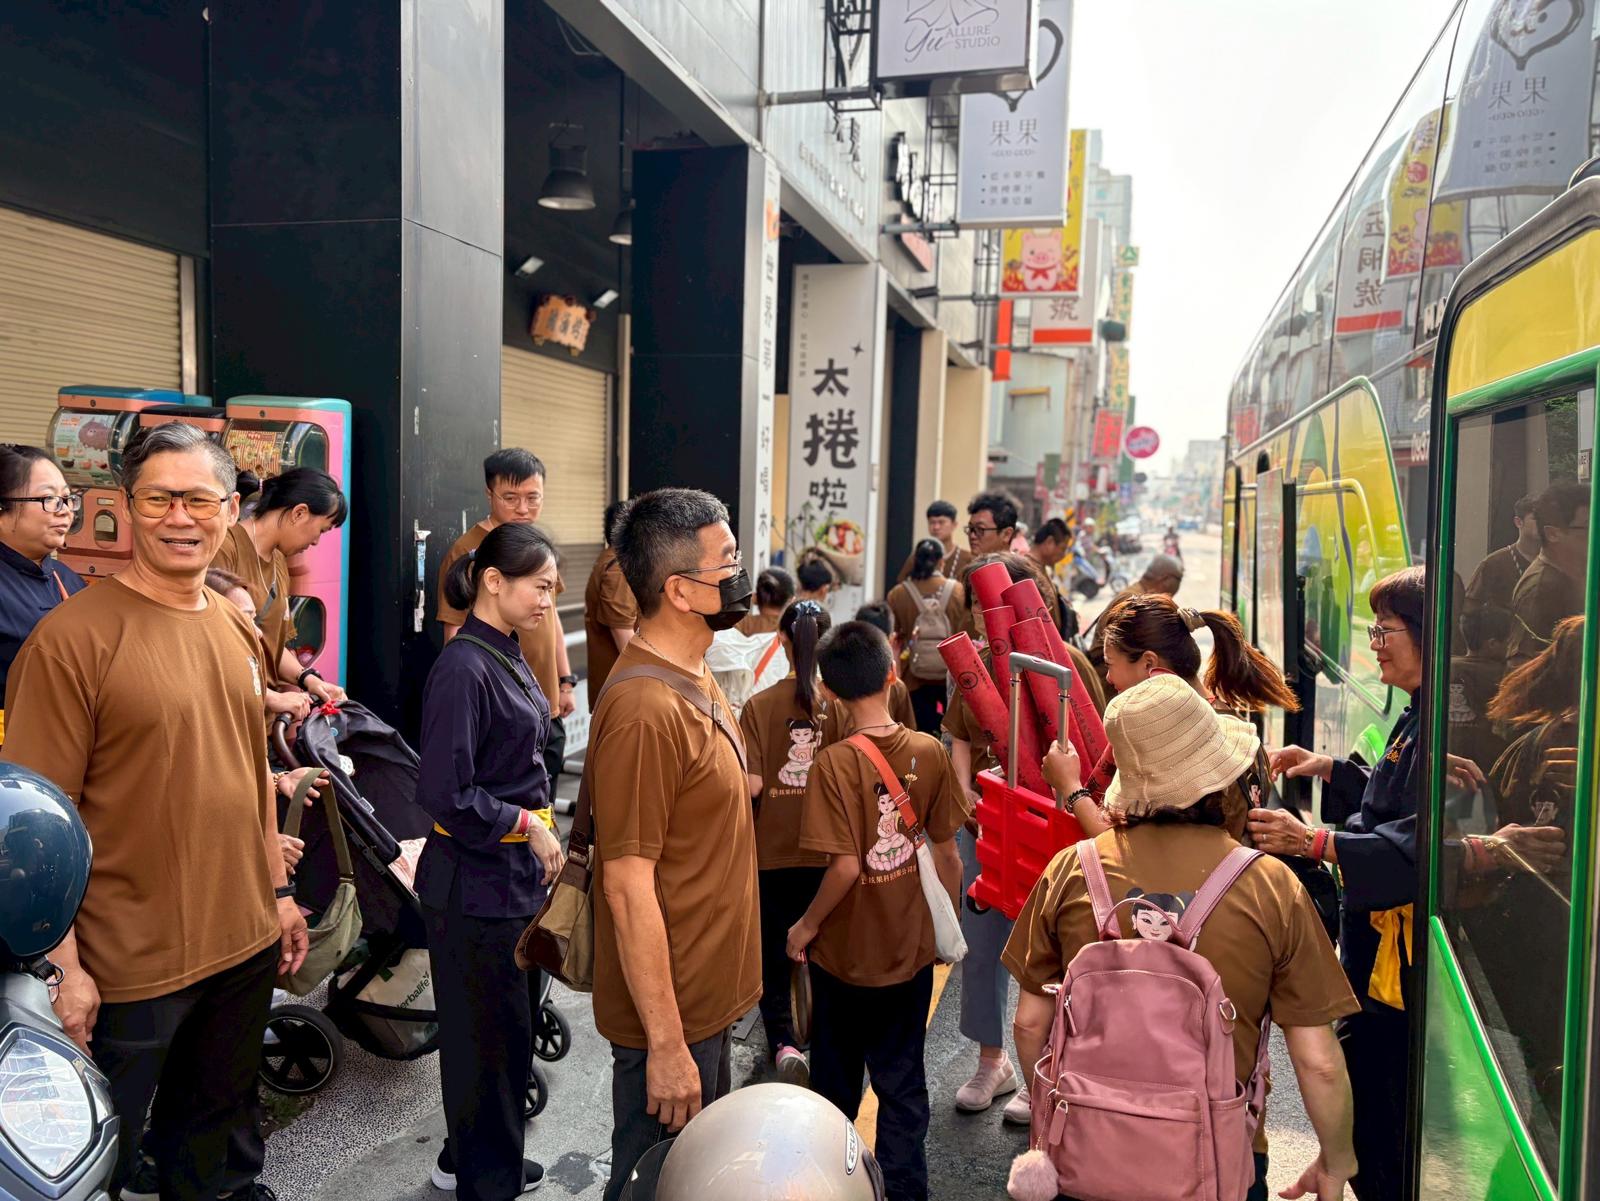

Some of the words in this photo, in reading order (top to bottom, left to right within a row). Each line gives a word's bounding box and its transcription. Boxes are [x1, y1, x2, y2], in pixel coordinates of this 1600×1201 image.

[945, 25, 991, 38] ALLURE
[955, 36, 1001, 49] STUDIO
[989, 118, 1038, 146] 果果
[803, 357, 859, 511] 太捲啦
